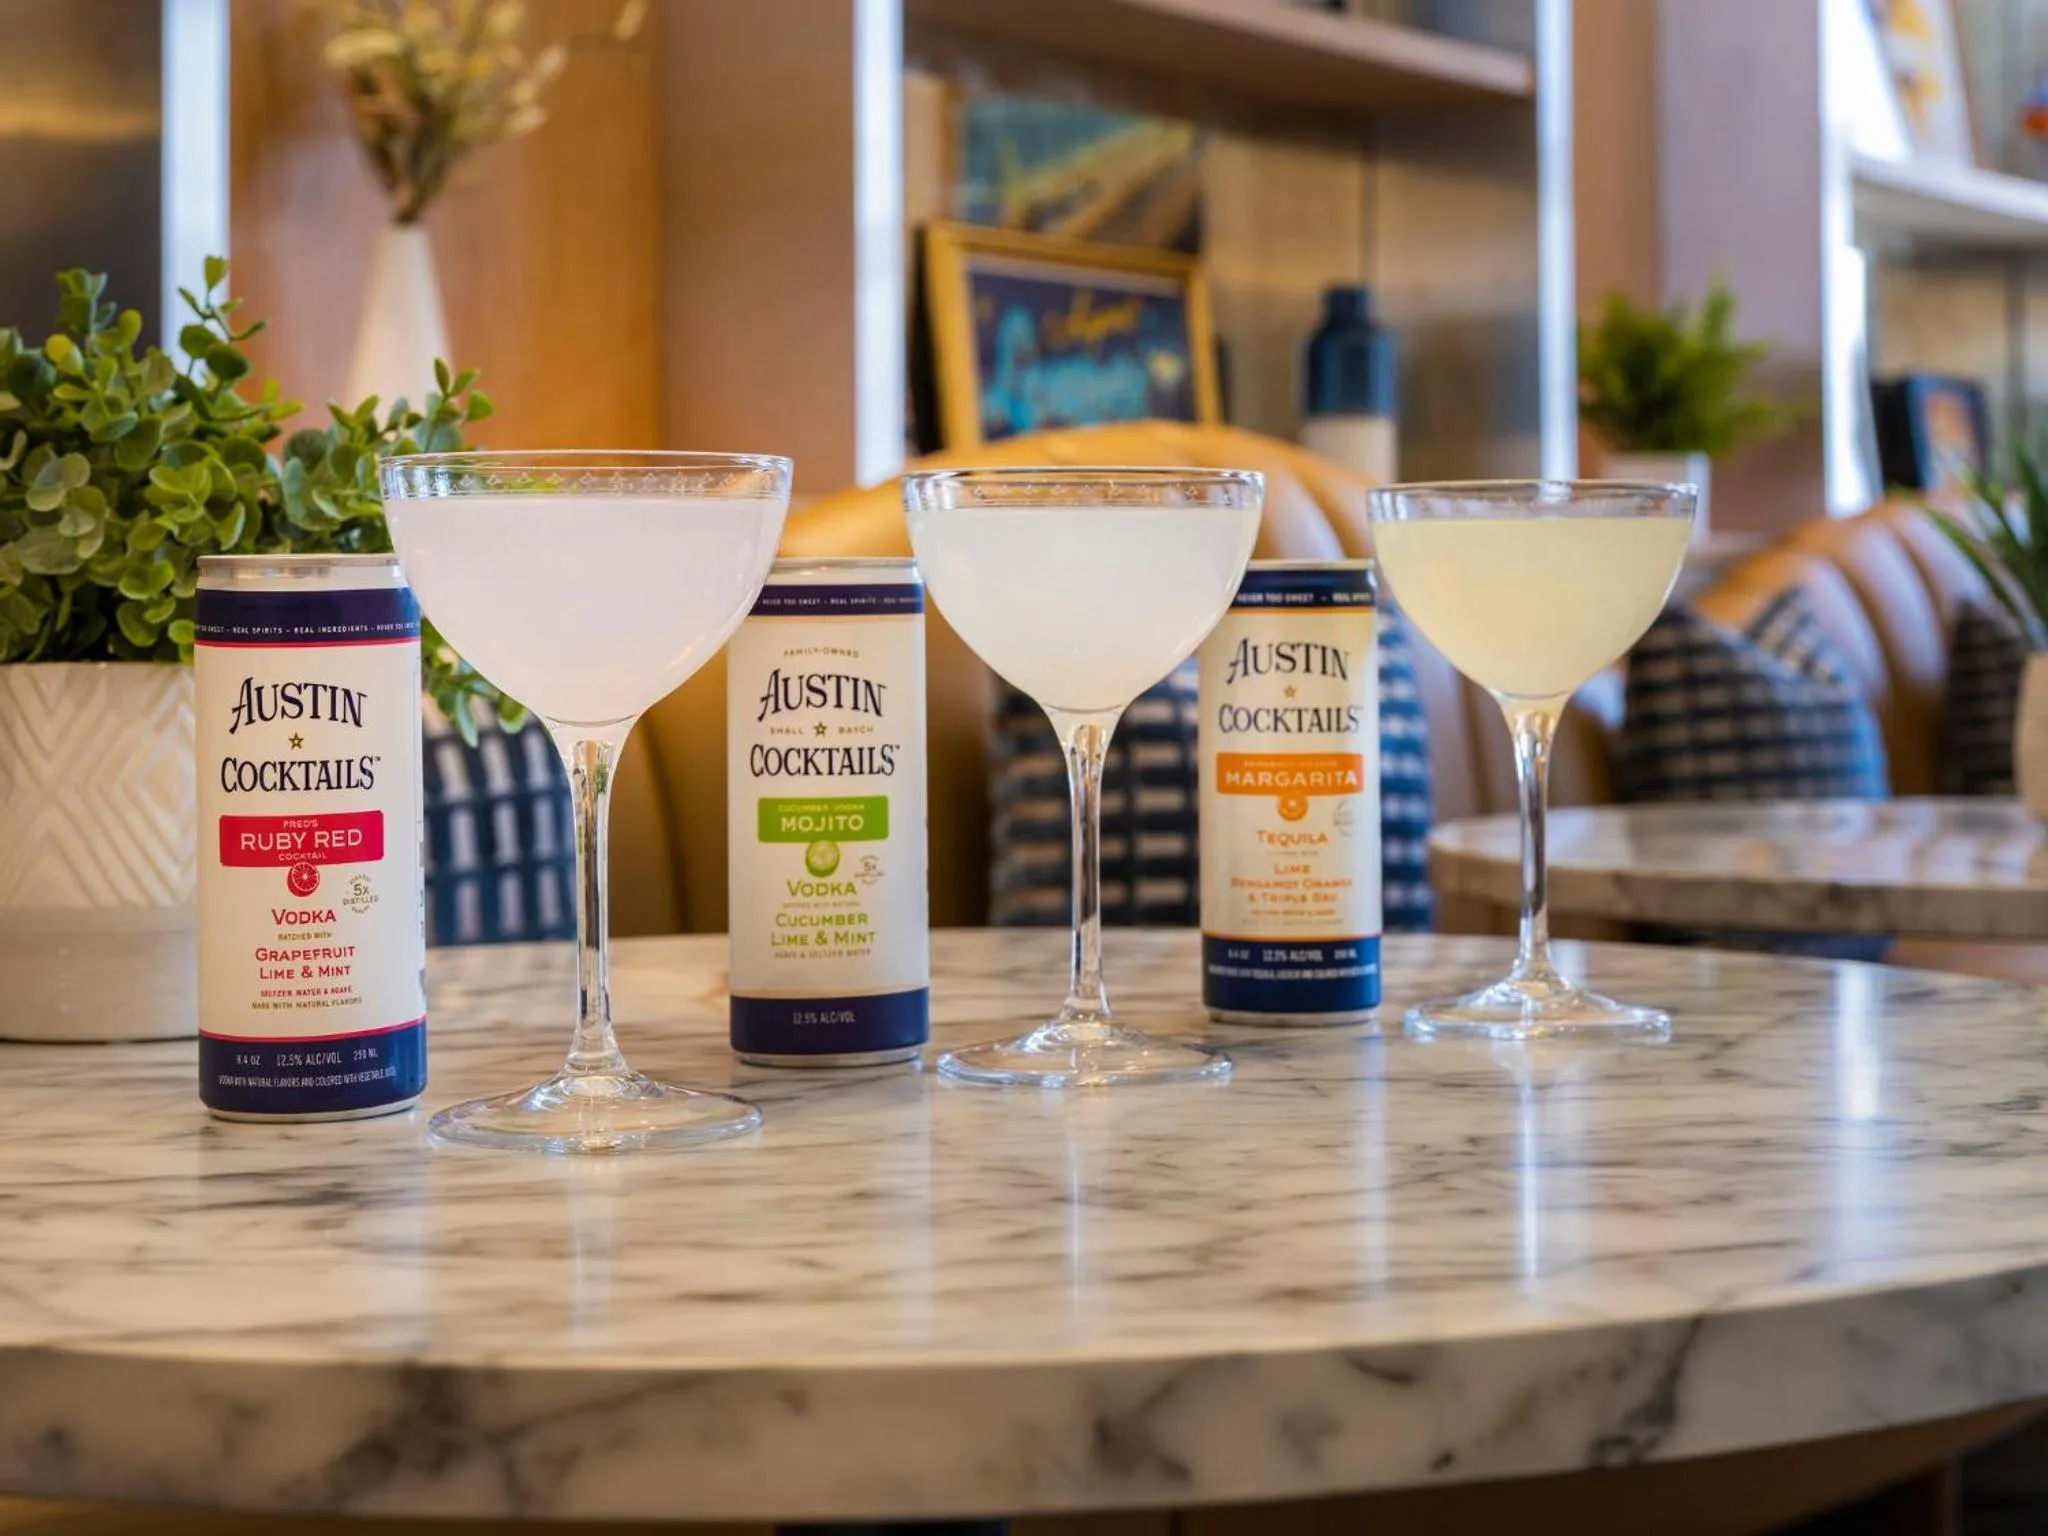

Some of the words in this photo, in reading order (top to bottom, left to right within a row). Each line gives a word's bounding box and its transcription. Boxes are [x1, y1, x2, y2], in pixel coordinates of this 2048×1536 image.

[294, 626, 314, 634] REAL
[318, 625, 368, 633] INGREDIENTS
[784, 647, 860, 659] FAMILY-OWNED
[1226, 637, 1350, 686] AUSTIN
[757, 667, 887, 722] AUSTIN
[229, 676, 368, 734] AUSTIN
[1218, 703, 1359, 734] COCKTAILS
[770, 726, 805, 735] SMALL
[838, 726, 874, 735] BATCH
[750, 743, 895, 777] COCKTAILS
[221, 755, 375, 793] COCKTAILS
[1225, 771, 1358, 788] MARGARITA
[283, 819, 318, 829] FRED'S
[781, 815, 864, 832] MOJITO
[241, 831, 306, 850] RUBY
[314, 828, 363, 848] RED
[1257, 830, 1328, 847] TEQUILA
[278, 852, 327, 861] COCKTAIL
[787, 880, 857, 897] VODKA
[271, 908, 337, 925] VODKA
[776, 913, 868, 927] CUCUMBER
[771, 931, 809, 946] LIME
[815, 930, 828, 945] &
[834, 931, 876, 945] MINT
[255, 946, 356, 962] GRAPEFRUIT
[260, 967, 295, 980] LIME
[301, 965, 313, 978] &
[318, 965, 352, 978] MINT
[261, 989, 293, 998] SELTZER
[296, 988, 322, 997] WATER
[296, 1001, 330, 1009] NATURAL
[820, 1010, 856, 1024] ALC/VOL
[277, 1054, 302, 1067] 12.5%
[304, 1052, 342, 1066] ALC/VOL
